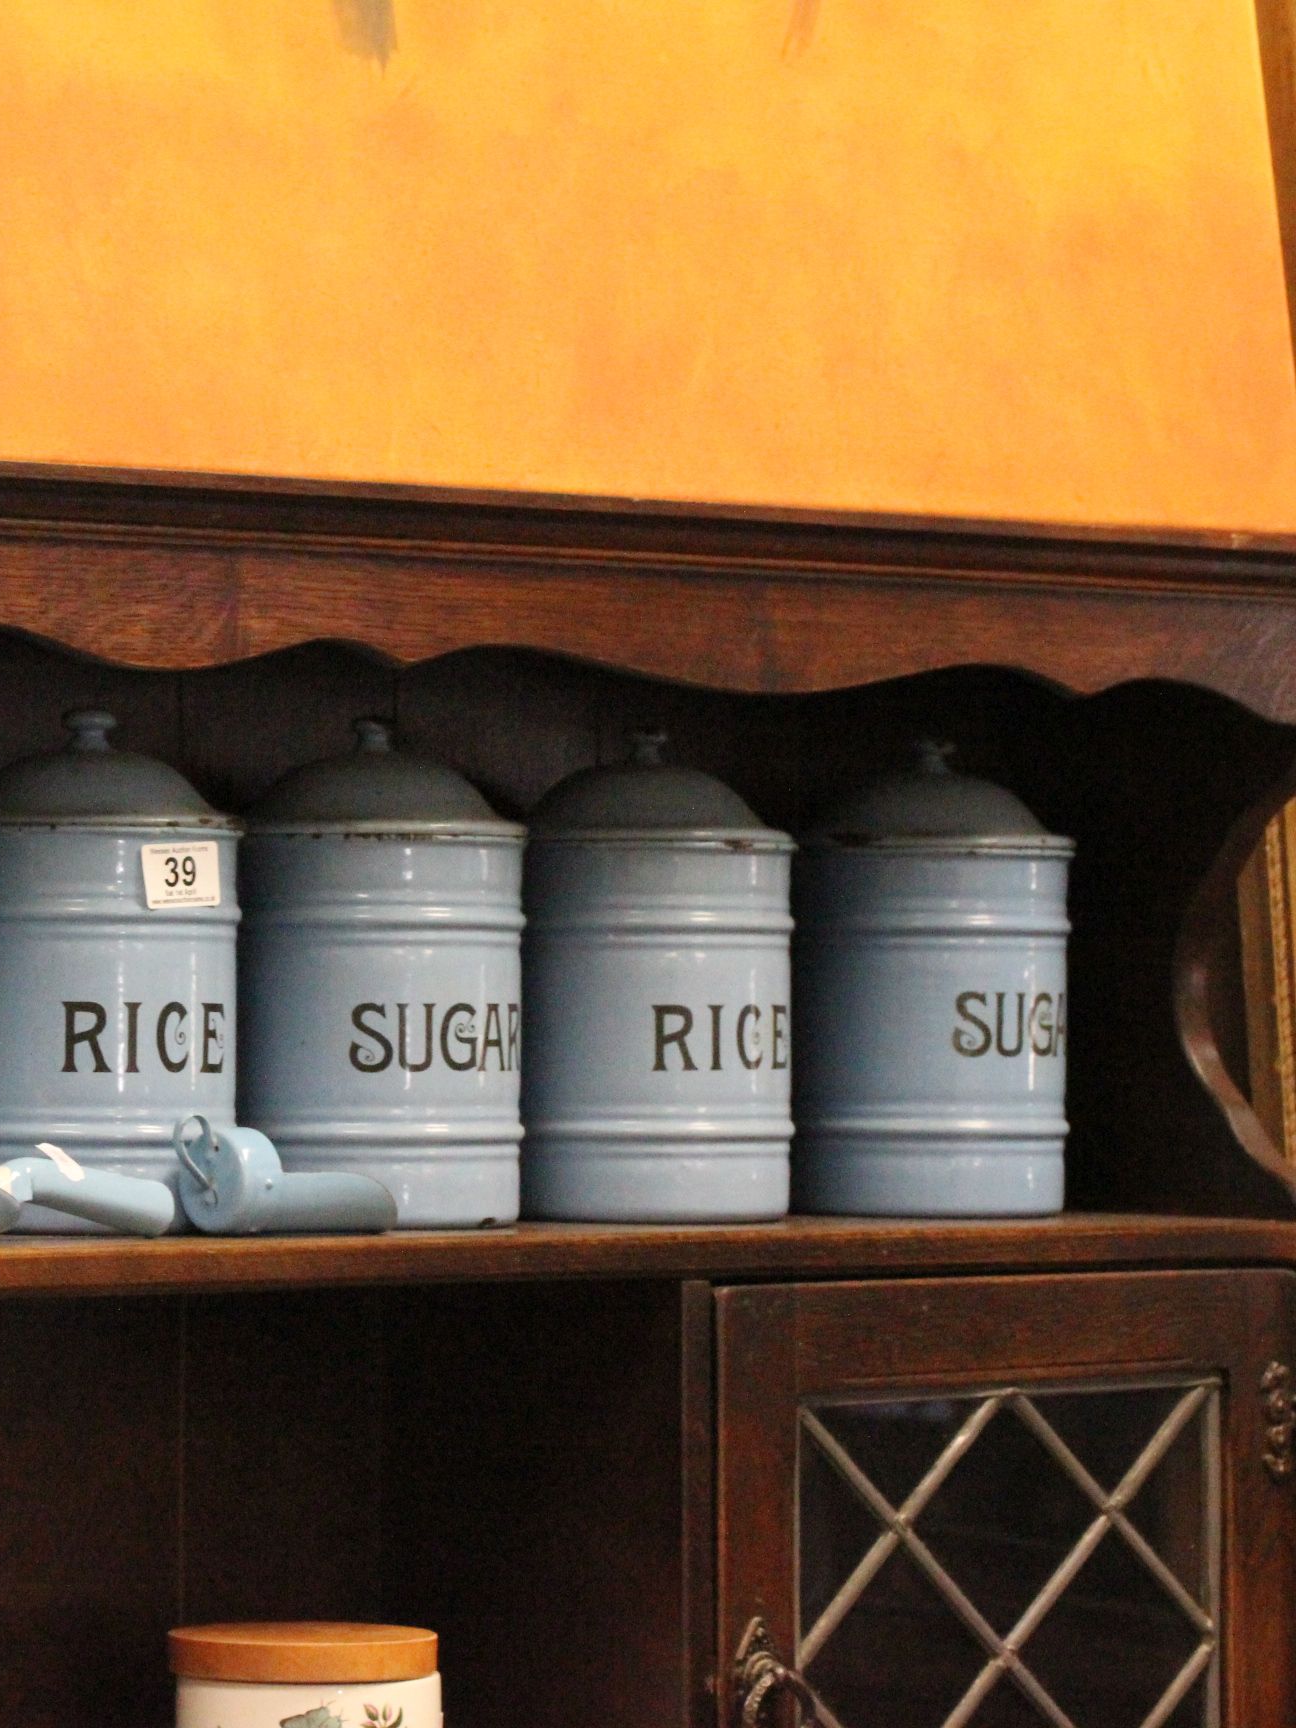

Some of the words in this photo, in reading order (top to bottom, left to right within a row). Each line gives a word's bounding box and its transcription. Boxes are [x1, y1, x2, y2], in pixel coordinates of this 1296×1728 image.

[165, 855, 197, 888] 39
[61, 1001, 225, 1074] RICE
[651, 1004, 788, 1072] RICE
